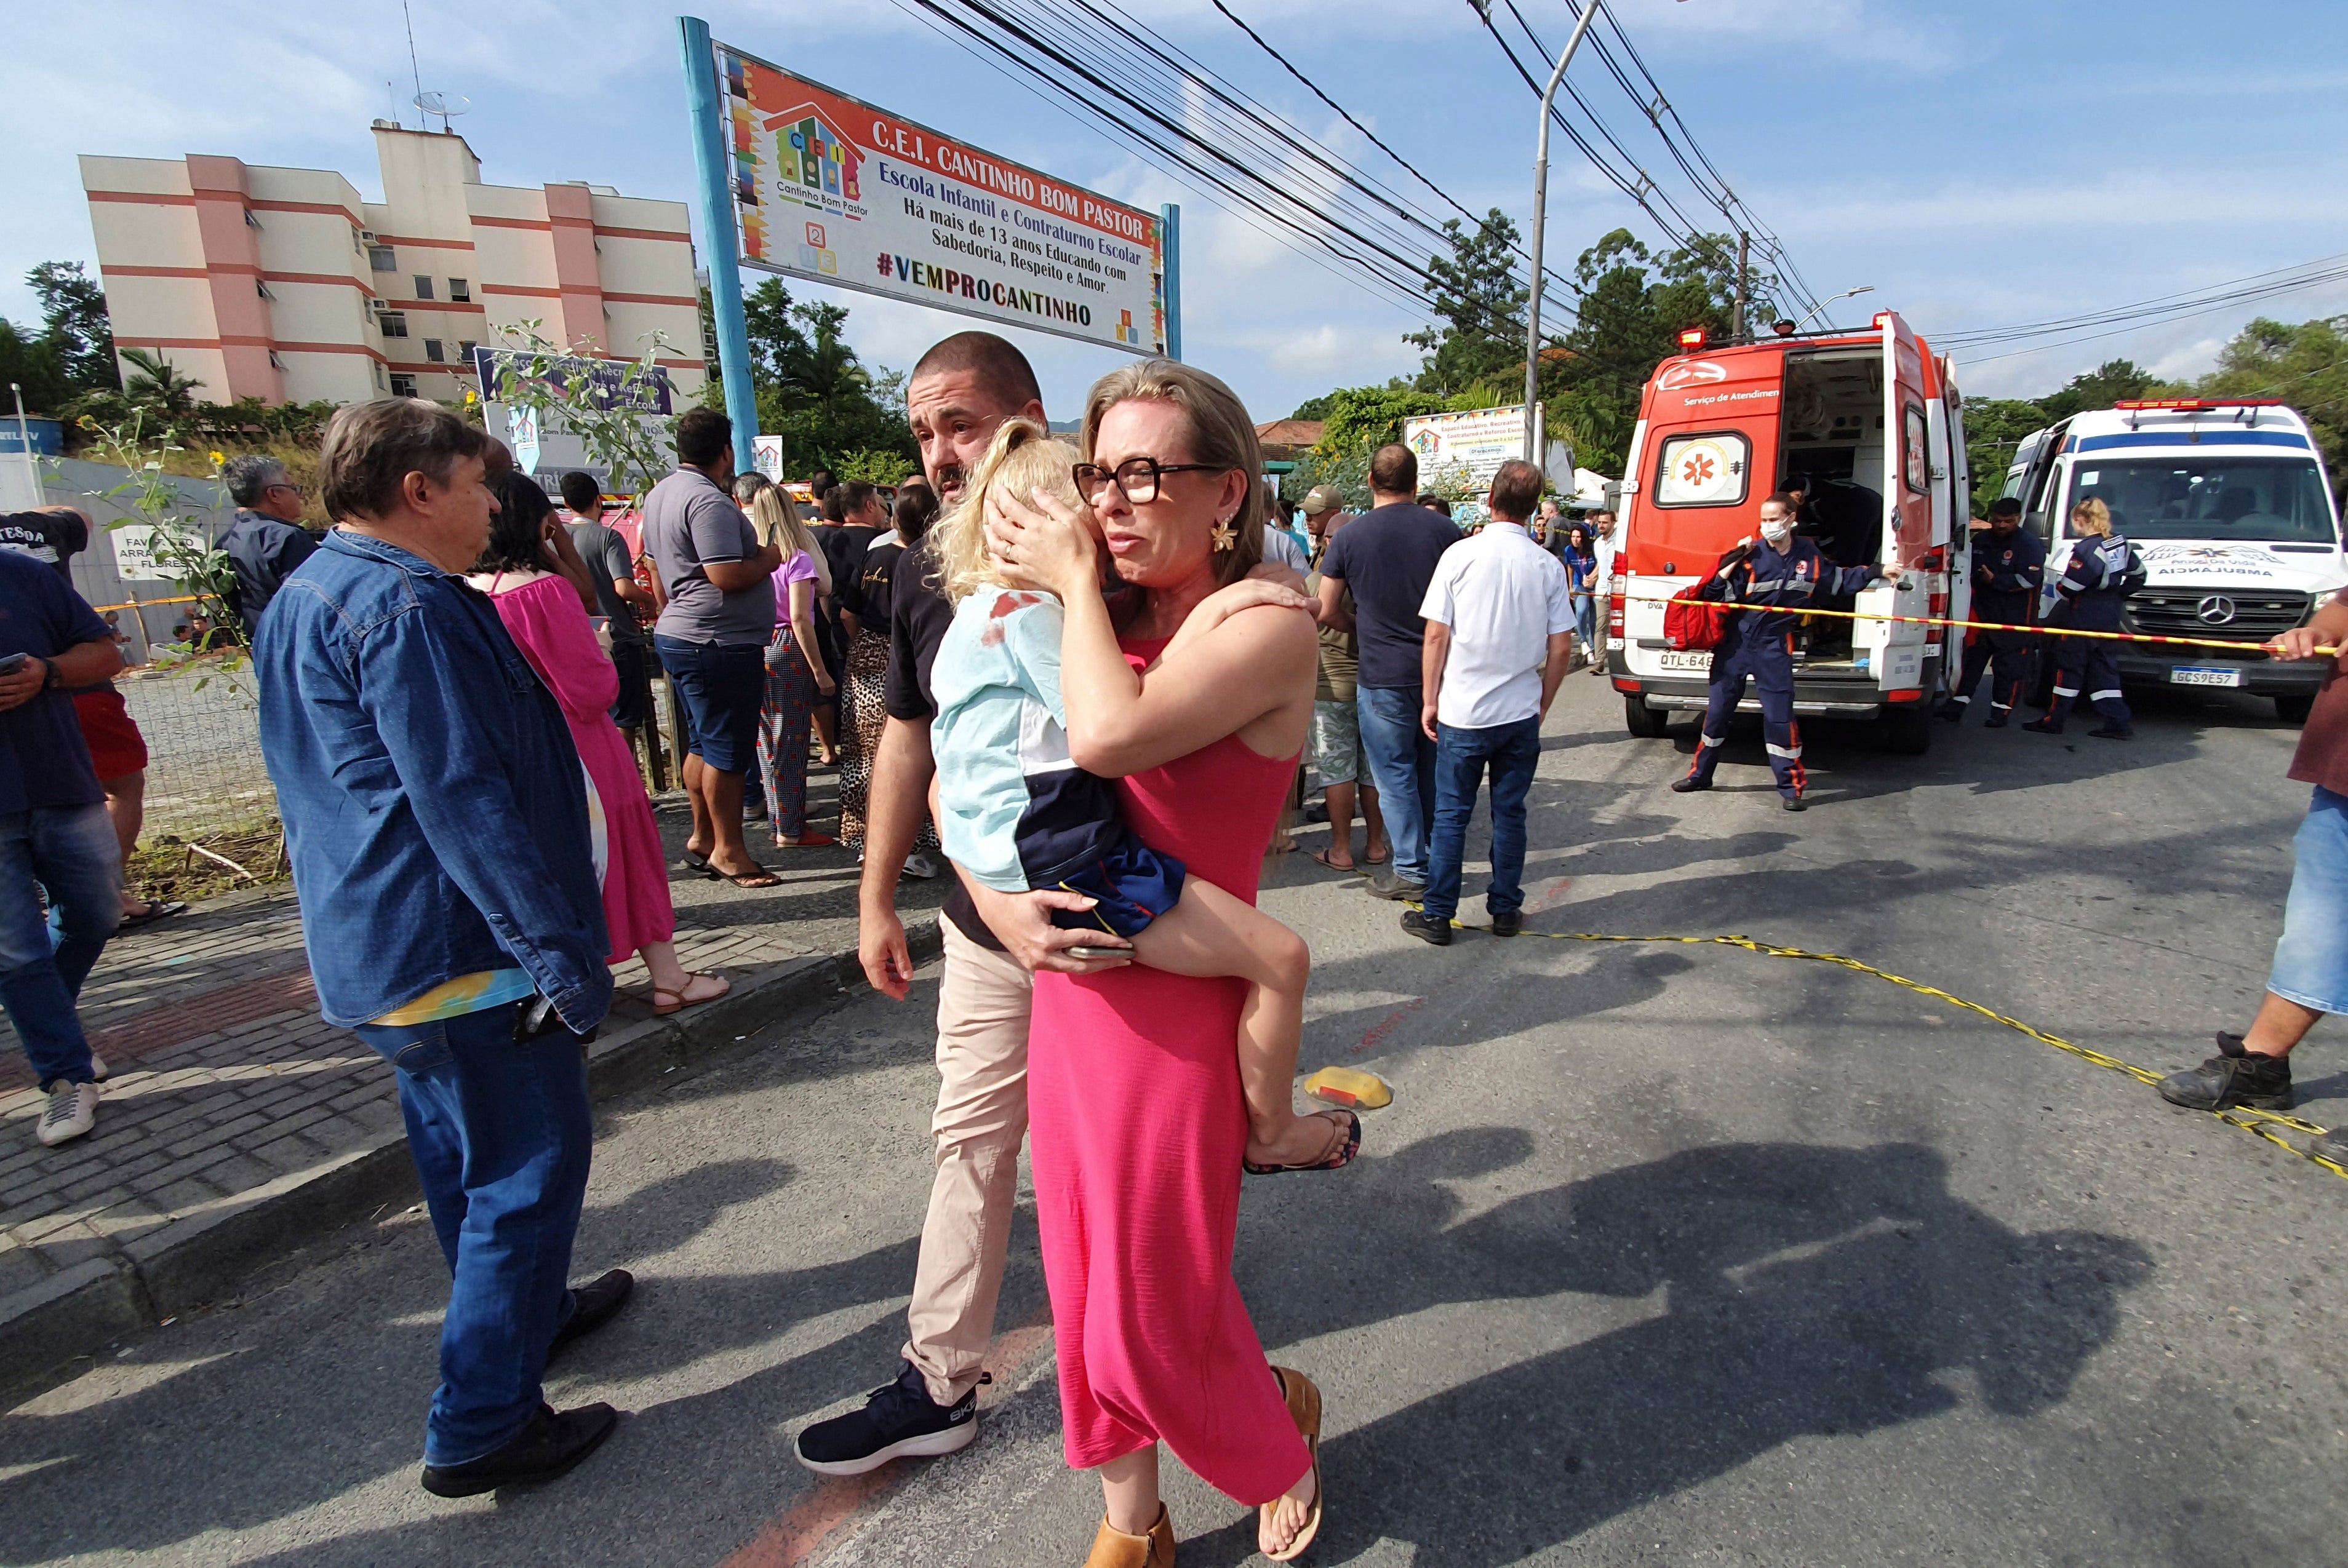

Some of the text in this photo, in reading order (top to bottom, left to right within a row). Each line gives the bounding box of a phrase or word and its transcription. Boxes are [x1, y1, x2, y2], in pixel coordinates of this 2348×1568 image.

[777, 181, 868, 216] Cantinho Bom Pastor
[873, 121, 1143, 241] C.E.I. CANTINHO BOM PASTOR
[879, 161, 1141, 266] Escola Infantil e Contraturno Escolar
[812, 228, 821, 242] 2
[904, 197, 1127, 282] Há mais de 13 anos Educando com
[932, 228, 1109, 294] Sabedoria, Respeito e Amor.
[877, 252, 1091, 327] #VEMPROCANTINHO
[1684, 389, 1779, 406] Serviço de Atendimen
[2177, 672, 2232, 685] GCS9E57
